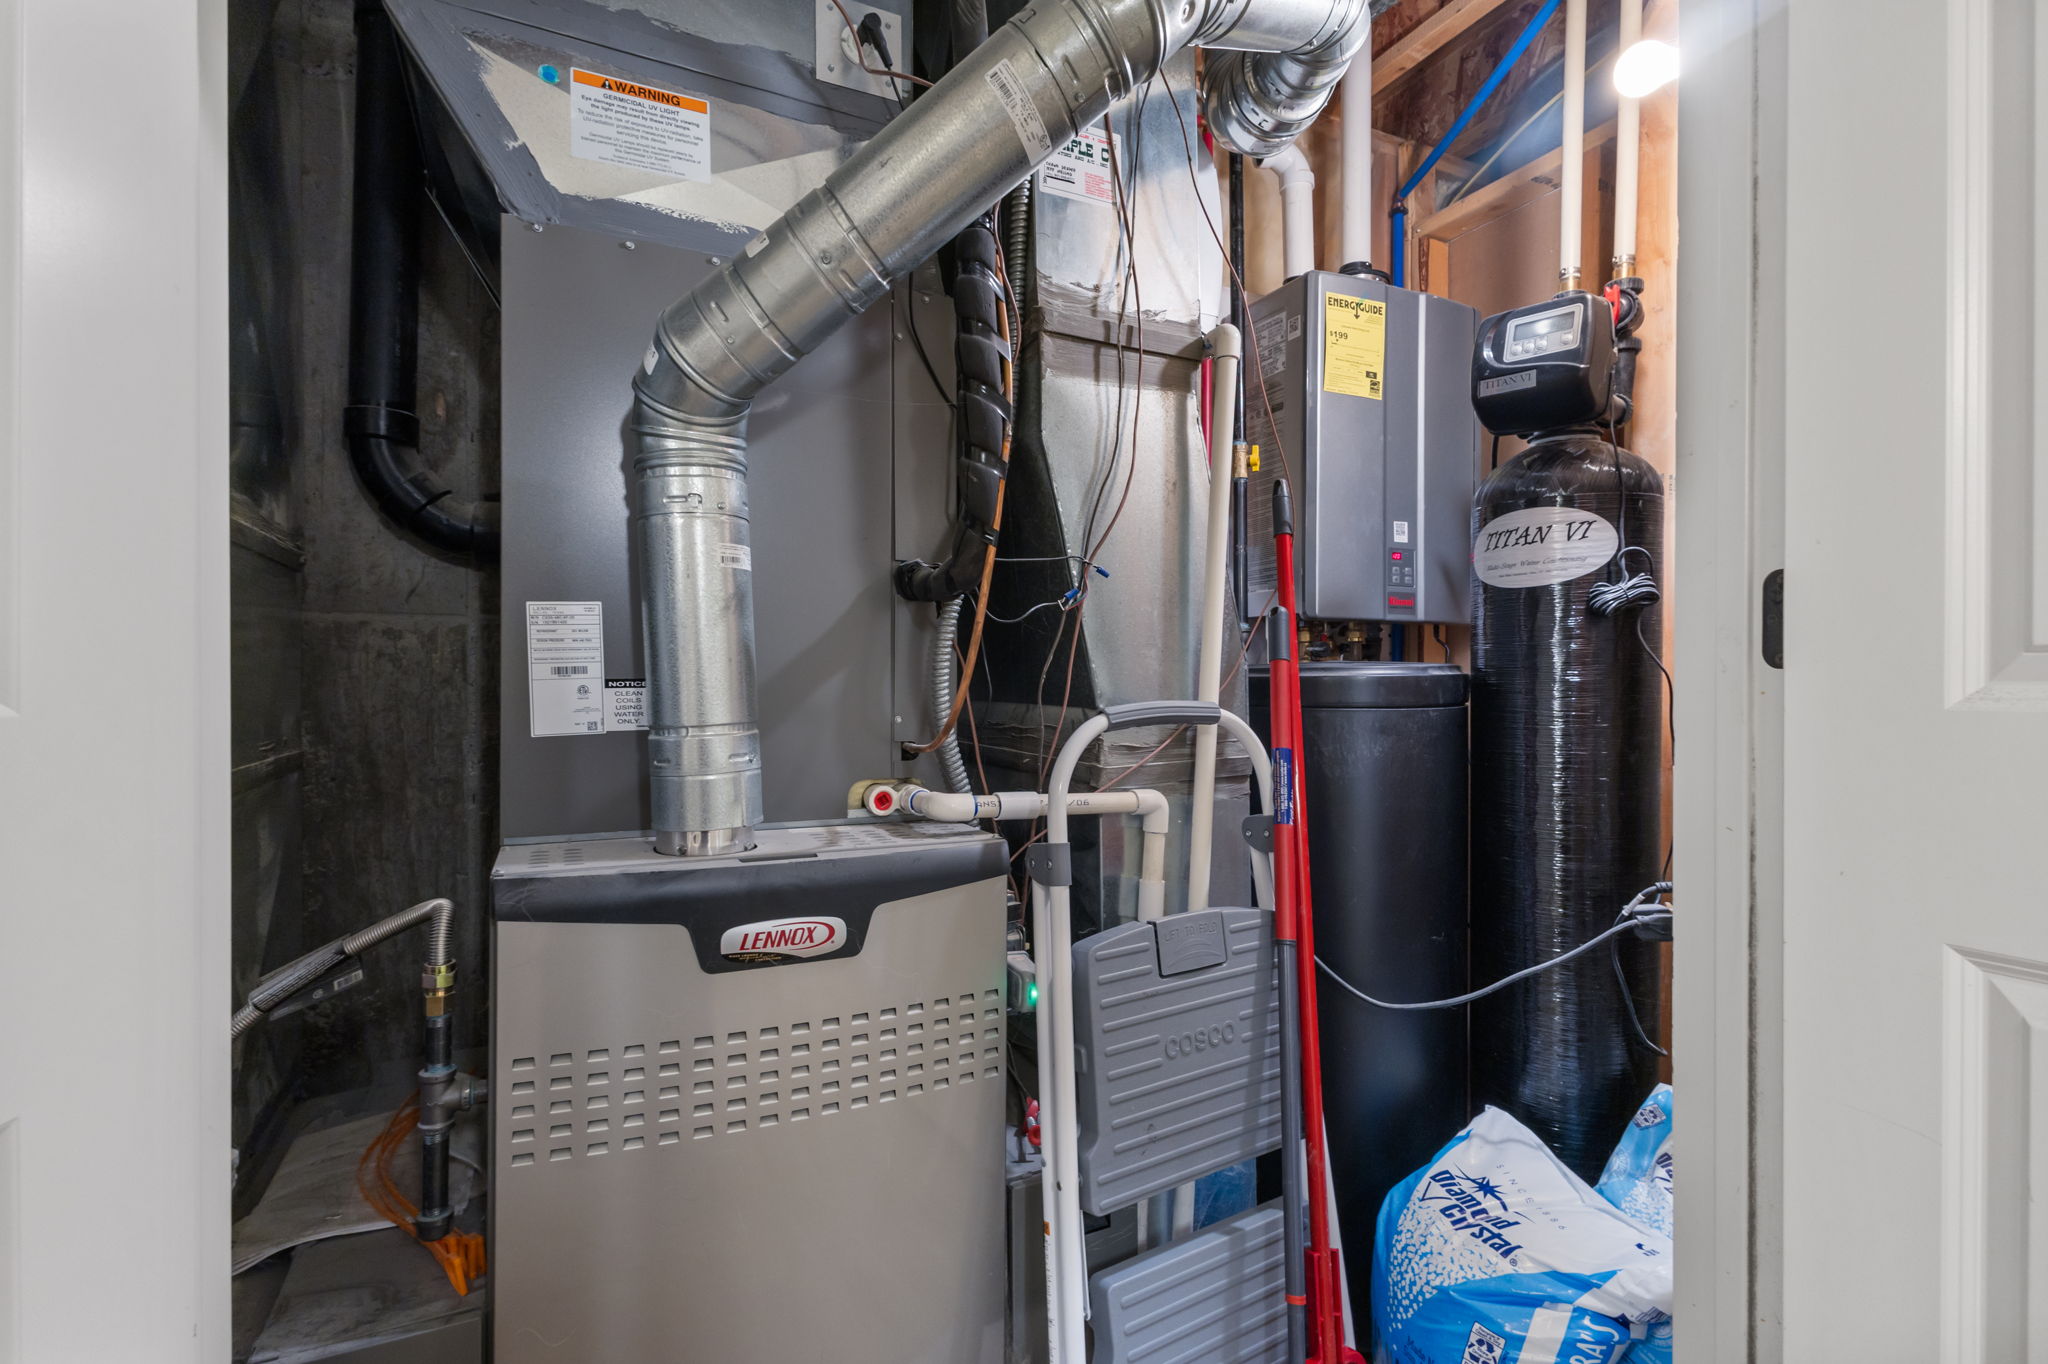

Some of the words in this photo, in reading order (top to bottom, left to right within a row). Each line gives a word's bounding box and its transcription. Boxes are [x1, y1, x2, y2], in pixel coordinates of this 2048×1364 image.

[603, 93, 647, 109] GERMICIDAL
[648, 103, 658, 111] UV
[659, 106, 680, 117] LIGHT
[615, 81, 681, 106] WARNING
[1064, 139, 1094, 158] PLE
[1485, 377, 1519, 391] TITAN
[1520, 373, 1533, 383] VI
[1484, 524, 1552, 553] TITAN
[1565, 520, 1597, 542] VI
[739, 926, 818, 951] LENNOX
[1165, 1020, 1234, 1059] COSCO
[1430, 1169, 1522, 1230] Diamond
[1439, 1204, 1524, 1259] Crystal
